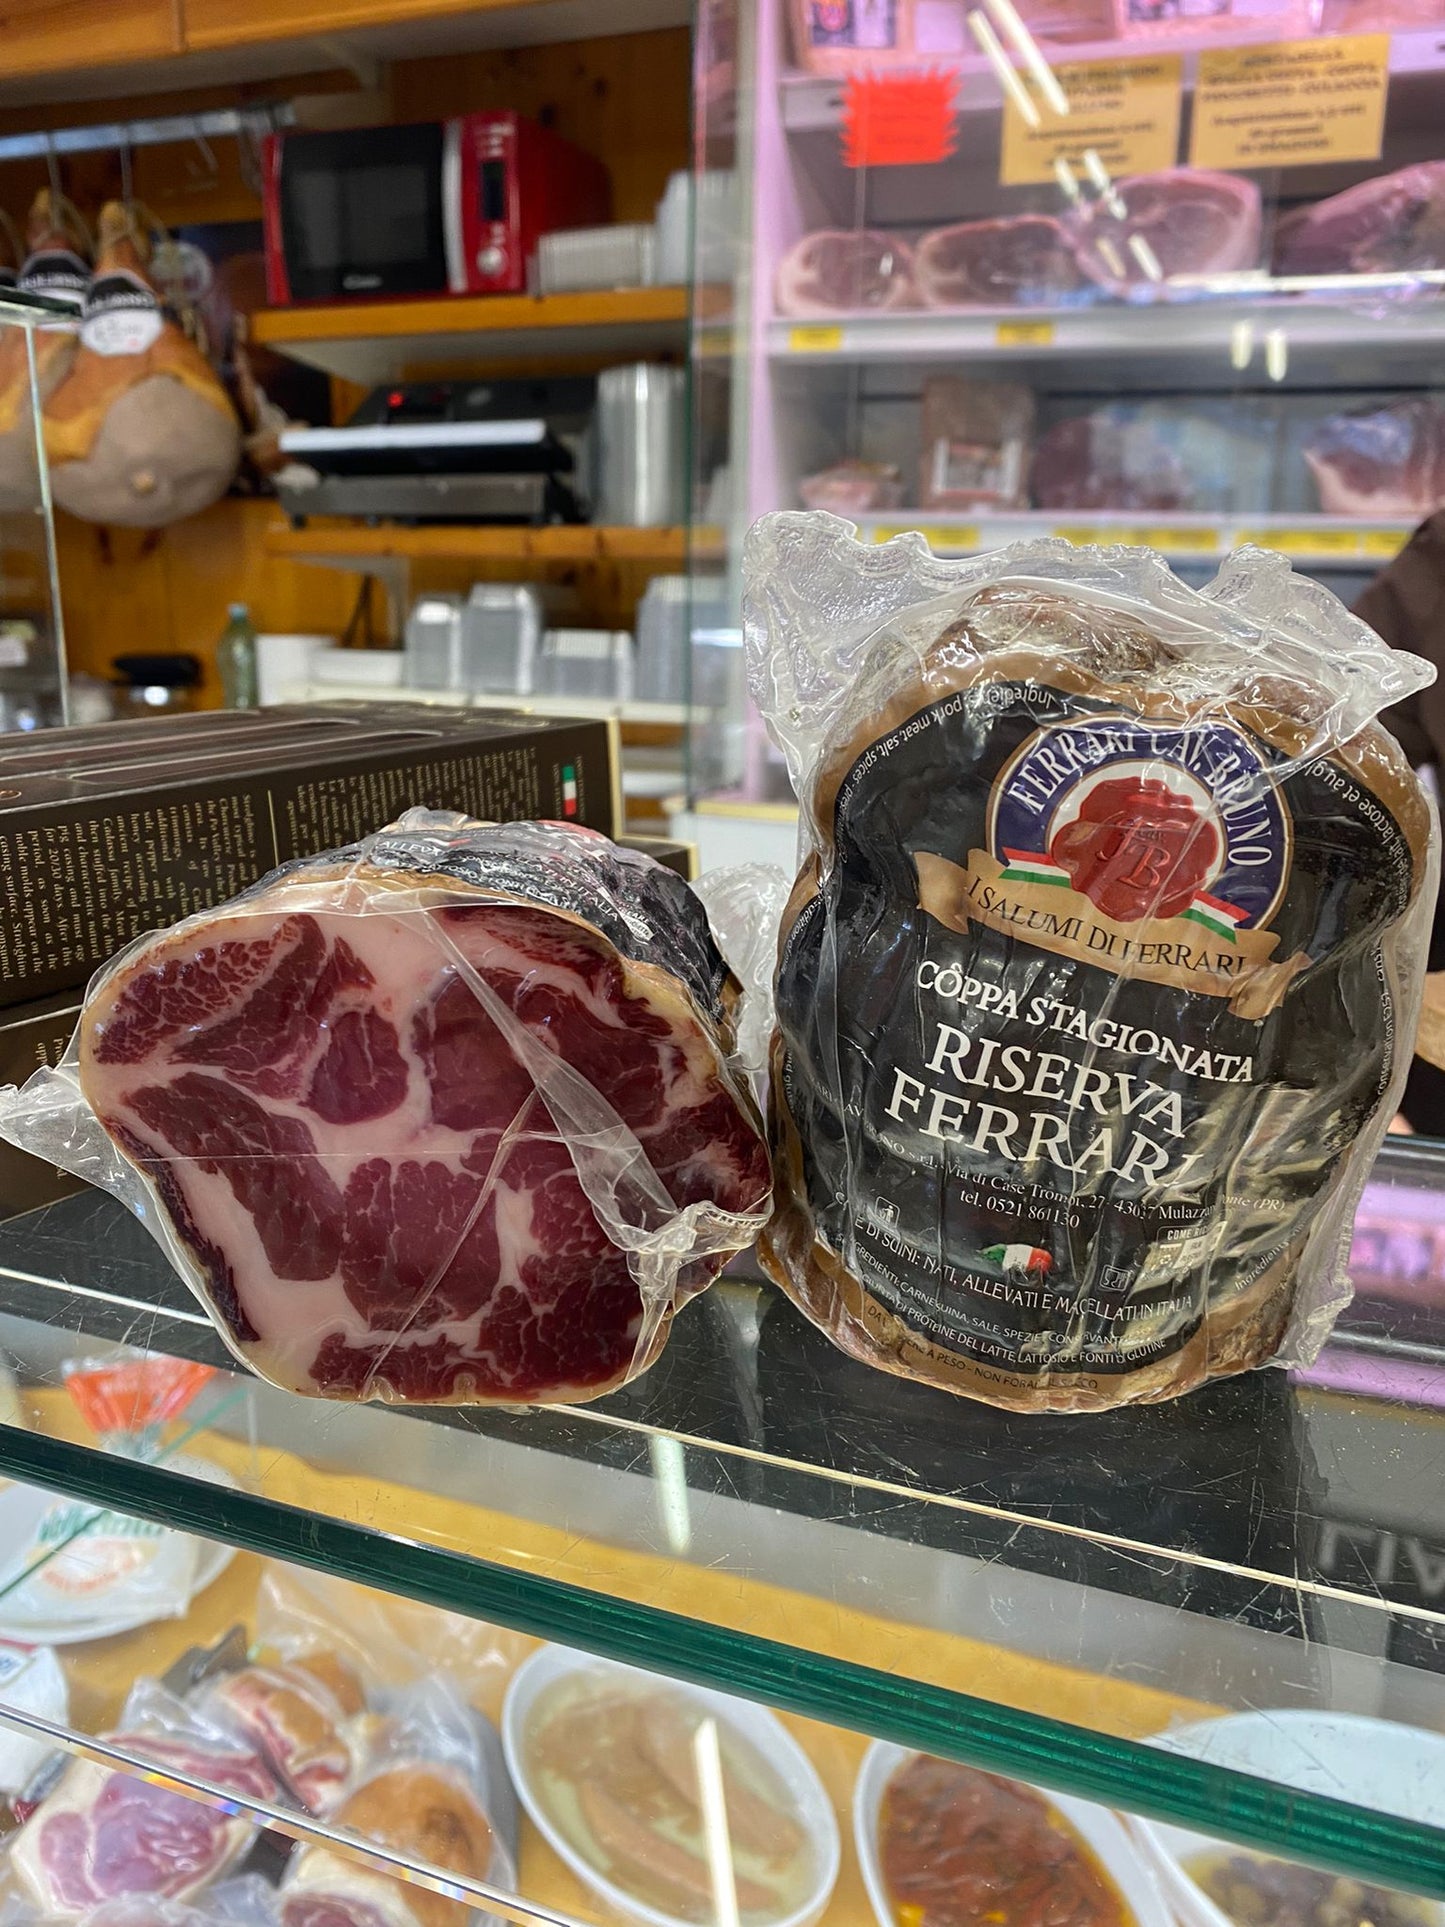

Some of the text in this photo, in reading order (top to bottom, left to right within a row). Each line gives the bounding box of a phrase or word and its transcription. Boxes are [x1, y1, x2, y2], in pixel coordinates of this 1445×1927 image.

[933, 694, 963, 725] pork
[207, 800, 216, 814] the
[1006, 728, 1274, 866] FERRARI CAV. BRUNO
[1324, 775, 1346, 792] au
[1341, 785, 1361, 802] et
[43, 828, 55, 842] for
[182, 804, 198, 870] consists of
[1358, 797, 1394, 846] lactose
[37, 877, 45, 889] as
[48, 849, 62, 879] 20/30
[117, 815, 137, 907] ancient recipe of
[131, 813, 150, 921] honey according to
[145, 840, 157, 872] pepper
[152, 880, 163, 899] and
[239, 862, 248, 881] and
[0, 835, 11, 871] casing
[12, 923, 26, 977] Strolghino
[15, 833, 43, 972] noble molds appear on the
[41, 899, 50, 923] soon
[57, 825, 84, 961] pig casing and must age
[74, 822, 101, 958] and characteristic natural
[89, 820, 114, 955] then stuffed into the thin
[166, 876, 176, 898] with
[45, 932, 52, 944] as
[57, 916, 68, 941] After
[977, 885, 1085, 942] SALUMI
[1085, 922, 1117, 954] DI
[1120, 939, 1250, 975] FERRARI
[47, 953, 58, 969] the
[62, 947, 72, 966] this
[1025, 996, 1254, 1083] STAGIONATA
[924, 1021, 1187, 1139] RISERVA
[884, 1066, 1204, 1188] FERRARI
[972, 1171, 986, 1186] di
[990, 1175, 1026, 1196] Case
[960, 1190, 1081, 1230] tel. 0521 861130
[881, 1233, 921, 1266] SUINI:
[961, 1273, 1038, 1309] ALLEVATI
[1041, 1294, 1053, 1309] E
[1055, 1296, 1137, 1322] MACELLATI
[1156, 1295, 1192, 1315] ITALIA
[899, 1280, 938, 1307] CARNE
[971, 1316, 1002, 1337] SALE,
[1003, 1327, 1040, 1343] SPEZIE
[906, 1307, 958, 1342] PROTEINE
[957, 1331, 978, 1351] DEL
[1018, 1350, 1069, 1365] LATTOSIO
[1079, 1350, 1115, 1364] FONTI
[1127, 1338, 1167, 1362] GLUTINE
[936, 1352, 966, 1372] PESO
[974, 1366, 1000, 1384] NON
